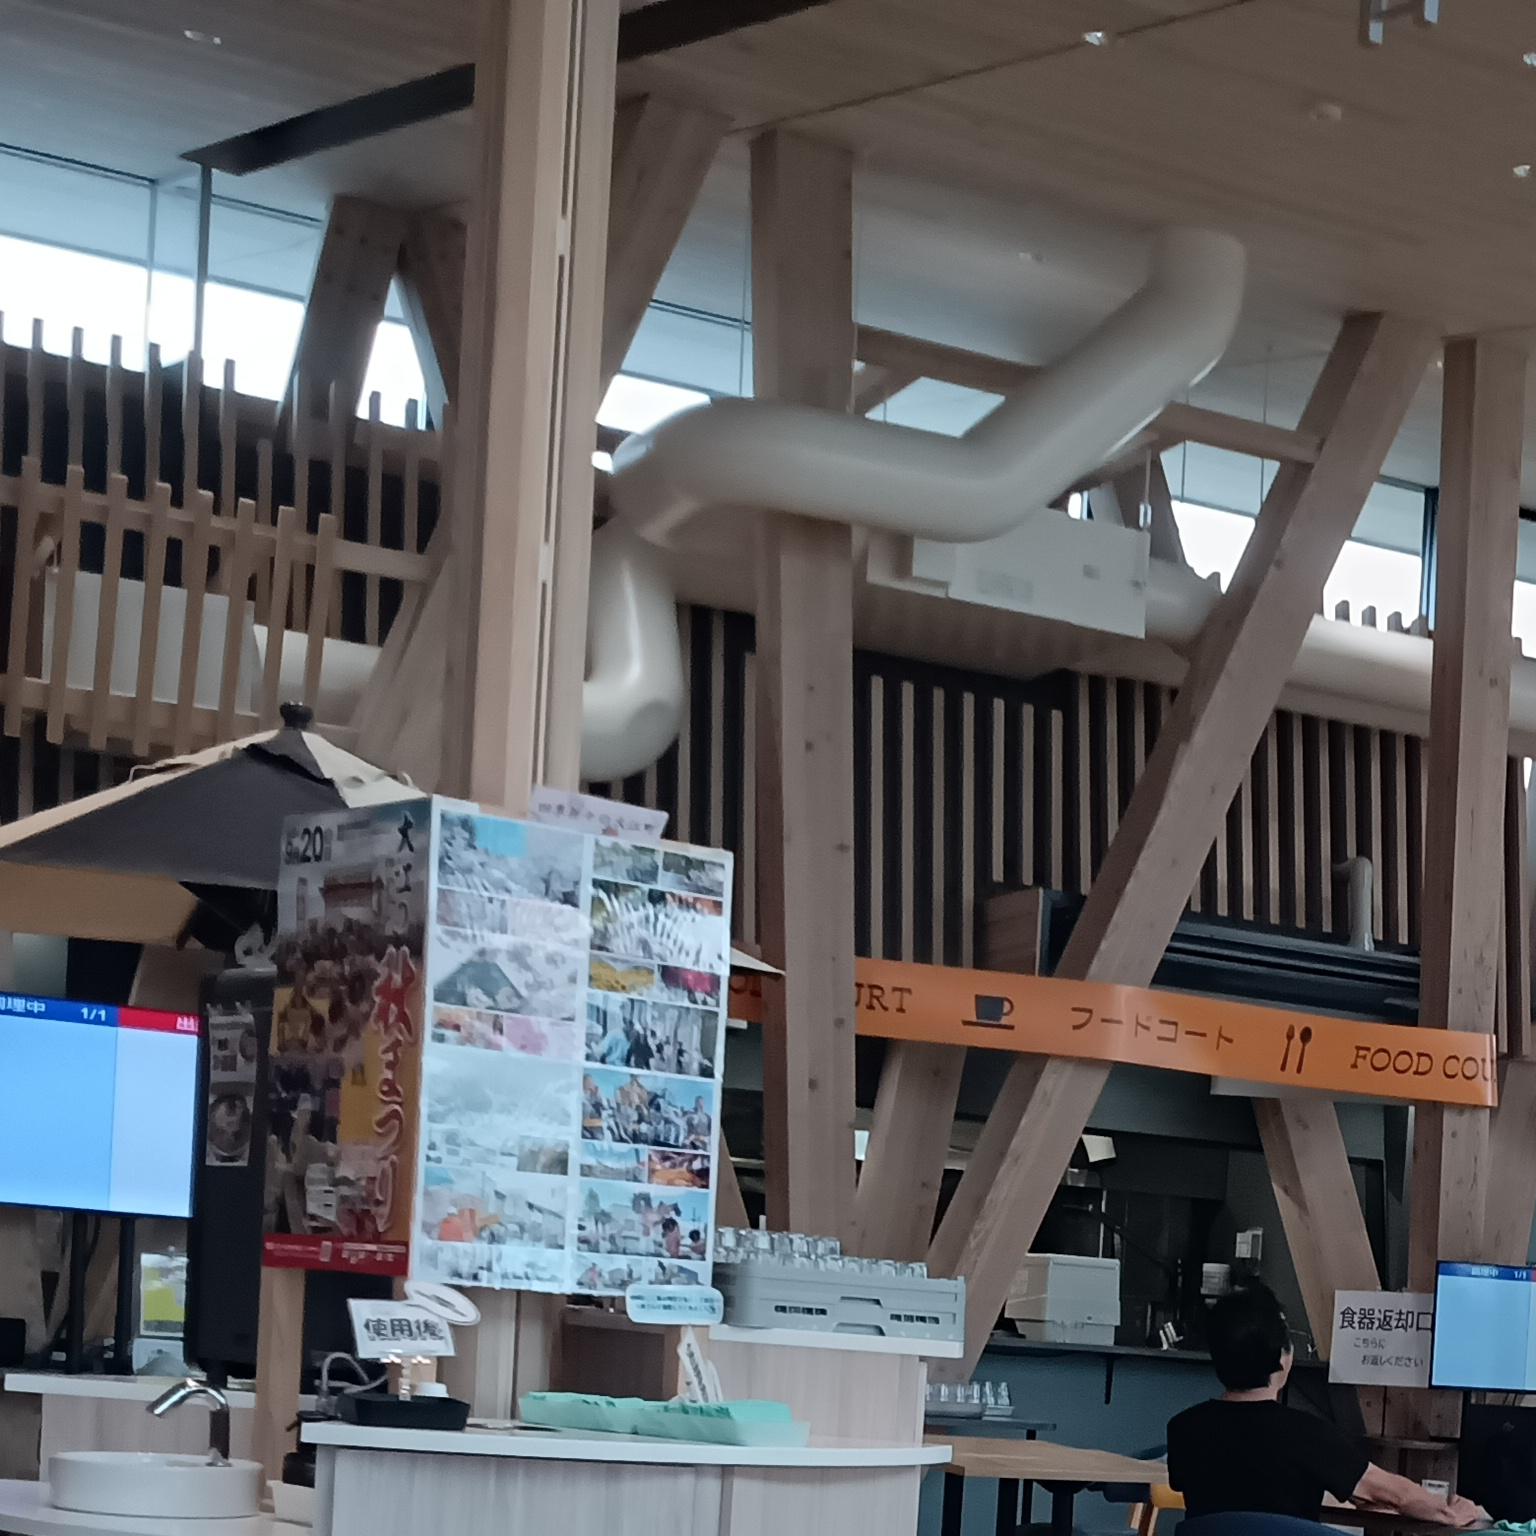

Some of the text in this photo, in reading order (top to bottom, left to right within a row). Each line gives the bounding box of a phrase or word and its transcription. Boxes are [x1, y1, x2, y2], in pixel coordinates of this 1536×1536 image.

[81, 1007, 106, 1022] 1/1
[1071, 1007, 1233, 1050] フードコート
[1350, 1045, 1433, 1076] FOOD
[1514, 1270, 1527, 1281] 1/1
[364, 1317, 445, 1341] 使用後
[1339, 1306, 1432, 1332] 食器返却口
[1361, 1354, 1424, 1368] お返しください
